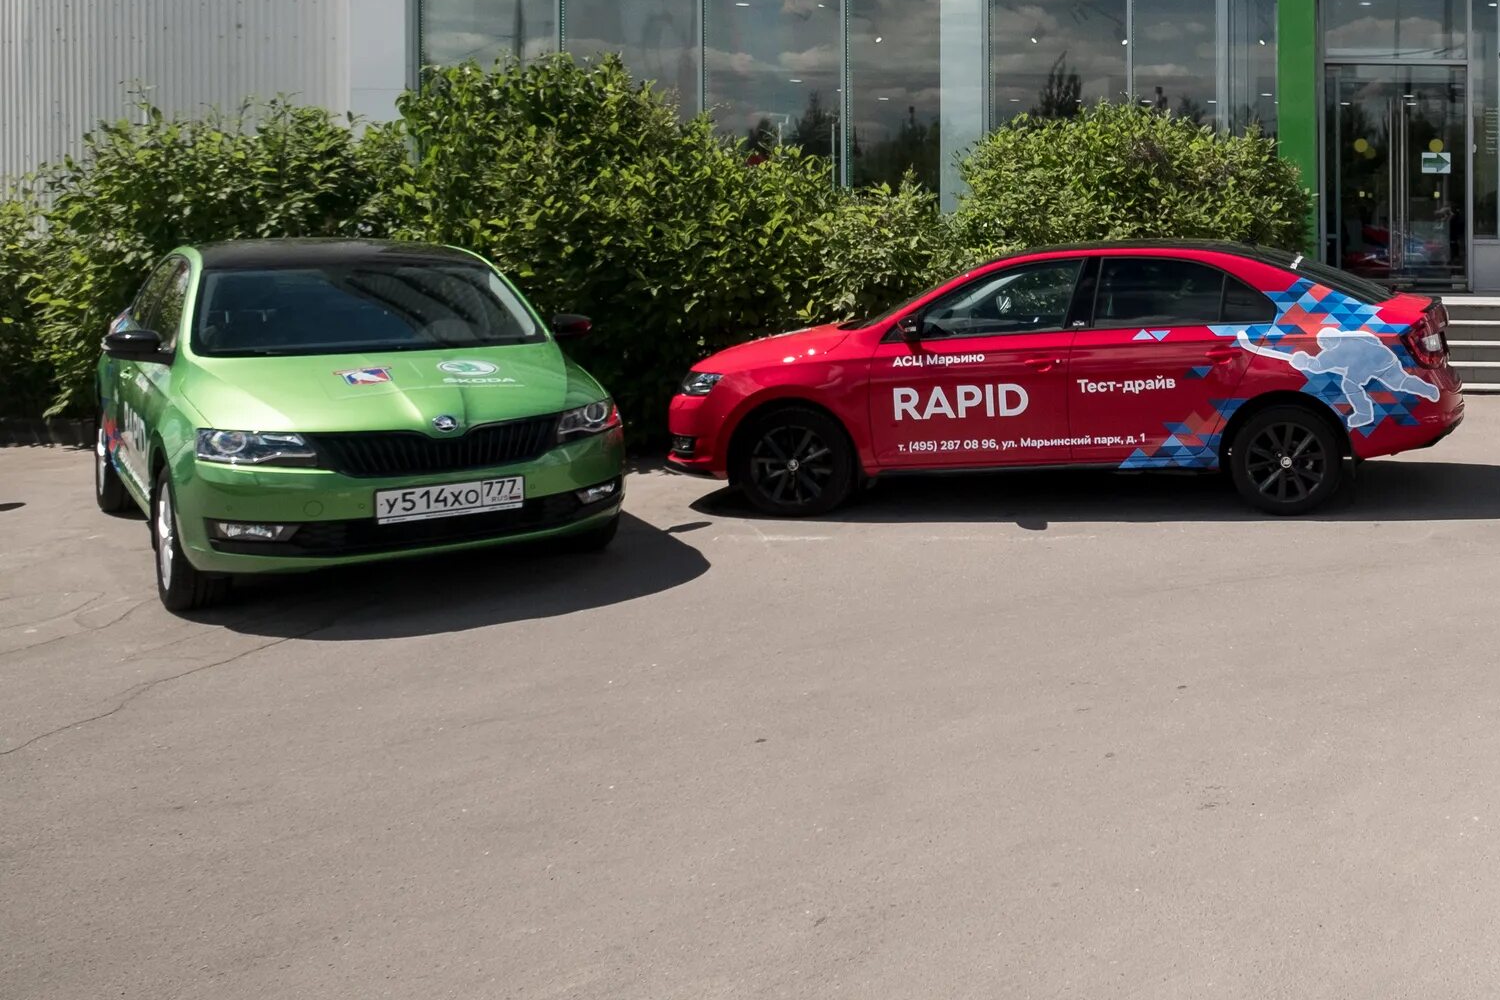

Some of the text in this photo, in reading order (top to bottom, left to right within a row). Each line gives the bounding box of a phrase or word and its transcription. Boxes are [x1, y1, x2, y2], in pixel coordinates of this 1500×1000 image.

[893, 352, 985, 368] АСЦ Марьино
[1077, 374, 1176, 395] Тест-драйв
[893, 383, 1029, 420] RAPID
[909, 440, 938, 453] (495)
[940, 440, 961, 450] 287
[963, 439, 979, 449] 08
[981, 438, 999, 450] 96,
[1001, 440, 1018, 450] ул.
[1020, 435, 1092, 448] Марьинский
[1094, 436, 1124, 446] парк,
[1126, 435, 1138, 445] д.
[1139, 432, 1146, 442] 1
[484, 478, 518, 497] 777
